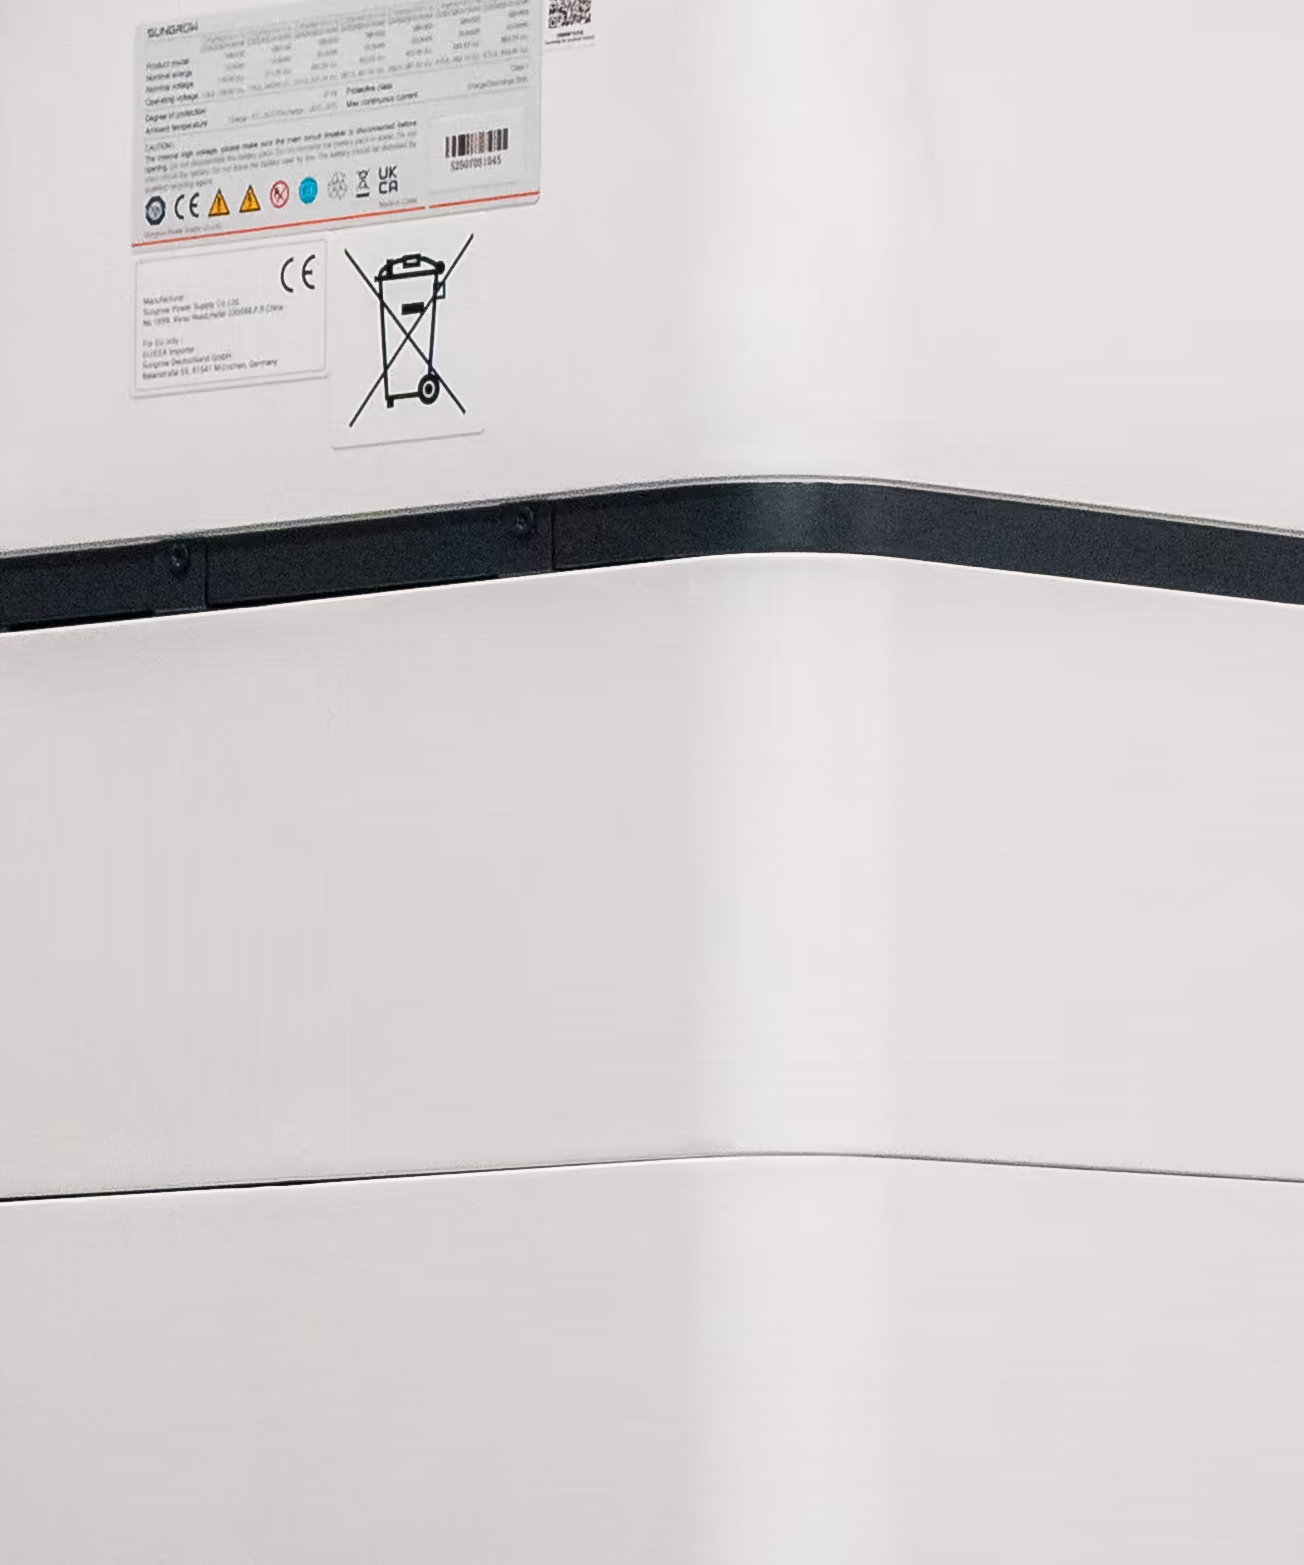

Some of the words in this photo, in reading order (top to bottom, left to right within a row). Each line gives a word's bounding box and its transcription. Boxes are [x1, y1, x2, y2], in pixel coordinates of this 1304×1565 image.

[147, 20, 198, 38] SUNGROW
[378, 164, 398, 180] UK
[378, 179, 398, 195] CA
